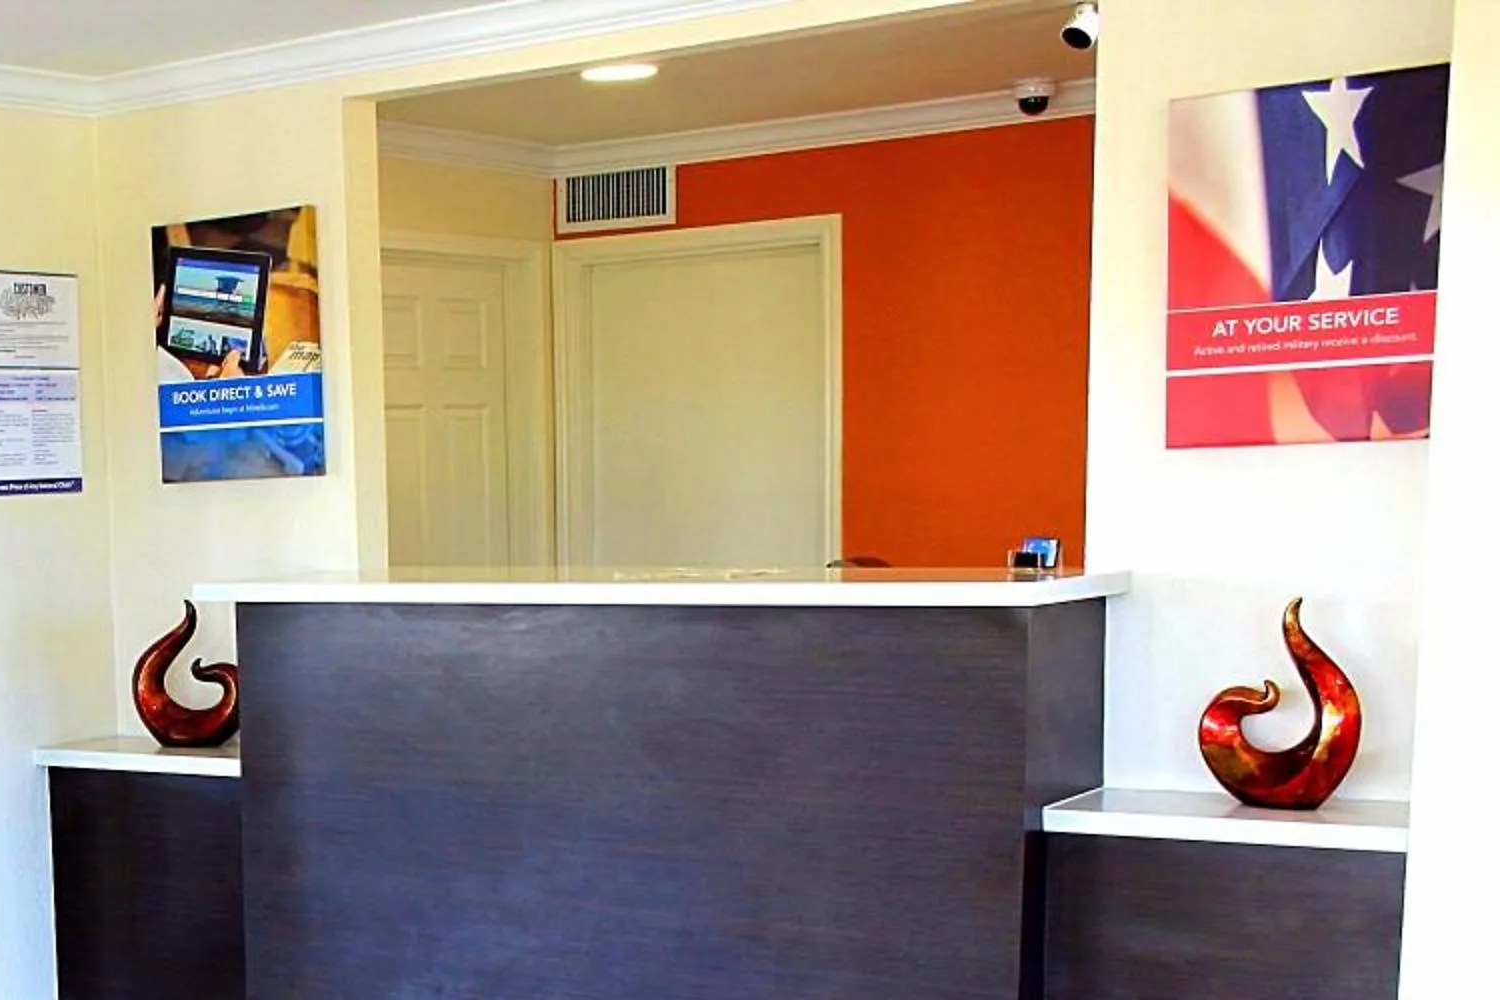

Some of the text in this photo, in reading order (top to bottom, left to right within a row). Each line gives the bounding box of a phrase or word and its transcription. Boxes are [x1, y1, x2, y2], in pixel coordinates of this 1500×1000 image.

[1212, 307, 1400, 337] AT YOUR SERVICE
[1226, 343, 1245, 355] and
[1247, 341, 1280, 353] retired
[1283, 338, 1319, 352] military
[172, 383, 297, 404] BOOK DIRECT & SAVE
